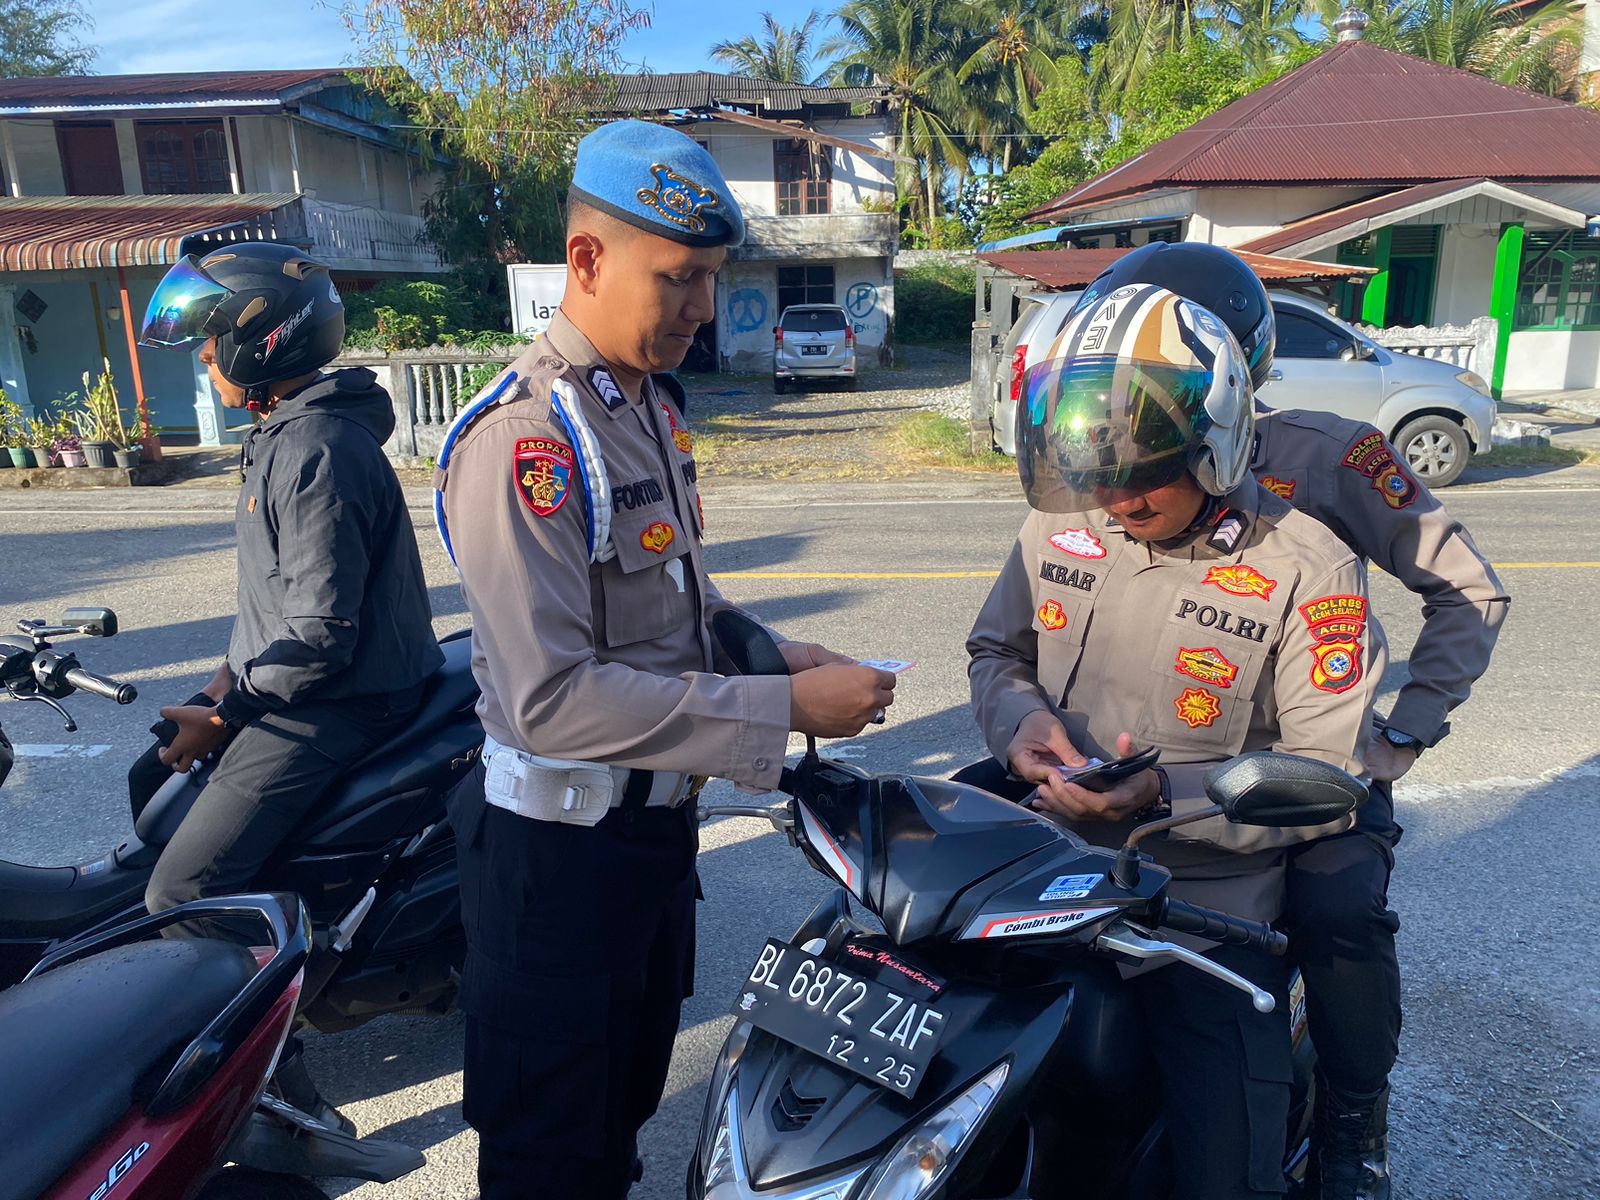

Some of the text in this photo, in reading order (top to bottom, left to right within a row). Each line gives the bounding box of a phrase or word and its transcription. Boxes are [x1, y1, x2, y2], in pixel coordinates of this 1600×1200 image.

[519, 441, 570, 458] PROPAM
[1367, 453, 1388, 472] ACEH
[1040, 560, 1096, 591] AKBAR
[1307, 598, 1363, 614] POLRES
[1310, 609, 1331, 622] ACEH
[1175, 598, 1269, 642] POLRI
[1320, 623, 1356, 635] ACEH
[1003, 911, 1085, 934] Combi Brake
[876, 951, 942, 992] Nusantara
[749, 943, 944, 1051] BL 6872 ZAF
